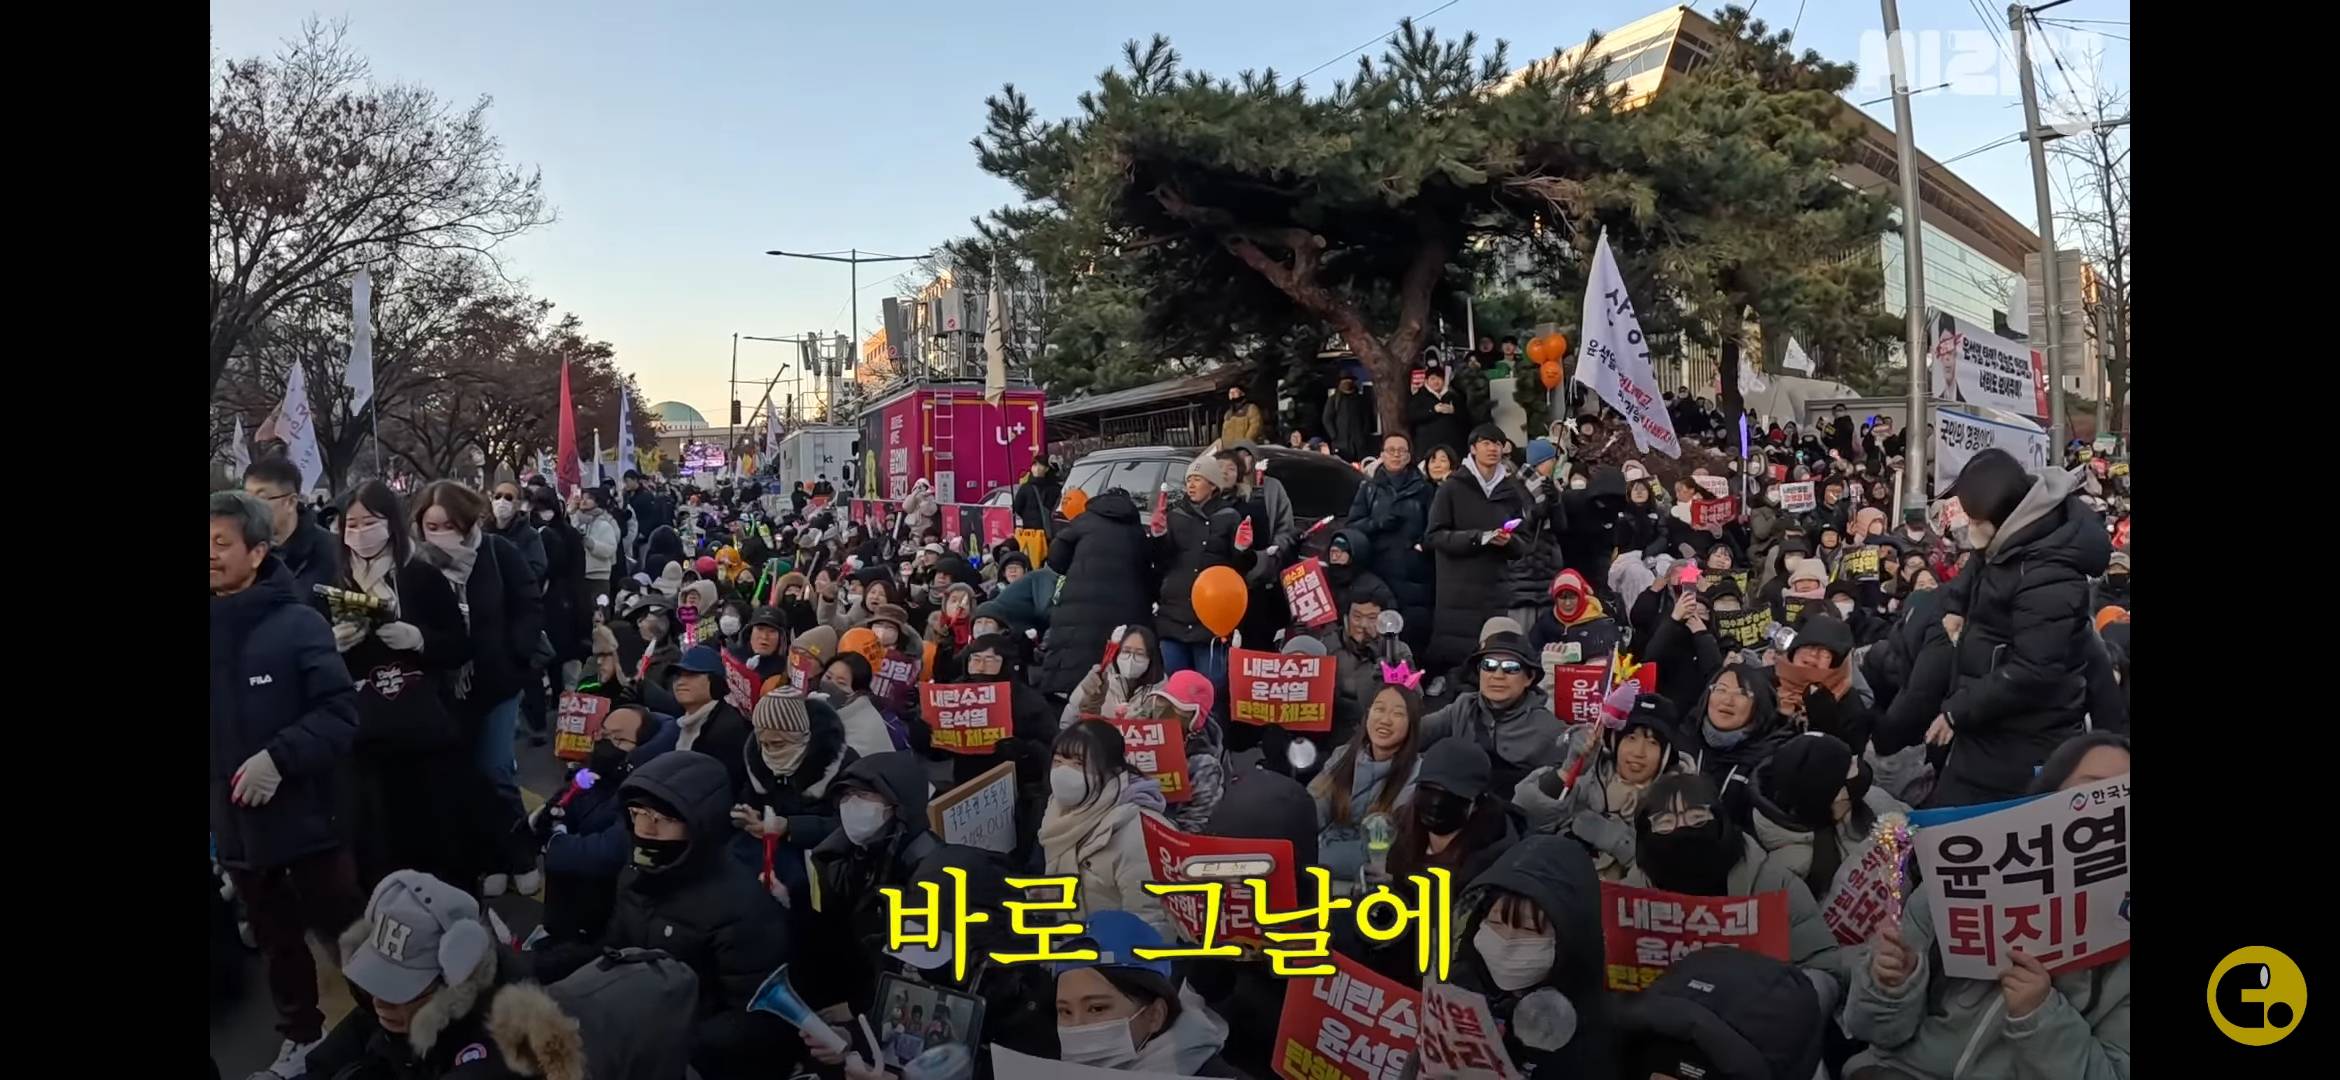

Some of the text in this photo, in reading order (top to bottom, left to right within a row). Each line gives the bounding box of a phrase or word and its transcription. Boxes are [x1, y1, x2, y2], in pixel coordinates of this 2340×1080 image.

[823, 455, 833, 464] kt
[1286, 570, 1321, 600] 윤석열
[249, 674, 272, 686] FILA
[1243, 657, 1320, 680] 내란수괴
[929, 685, 996, 708] 내란수괴
[1251, 681, 1309, 702] 윤석열
[939, 707, 988, 728] 윤석열
[1236, 700, 1326, 724] 탄핵! 체포!
[1936, 806, 2128, 900] 윤석열
[1618, 897, 1758, 936] 내란수괴
[1948, 891, 2088, 967] 퇴진!
